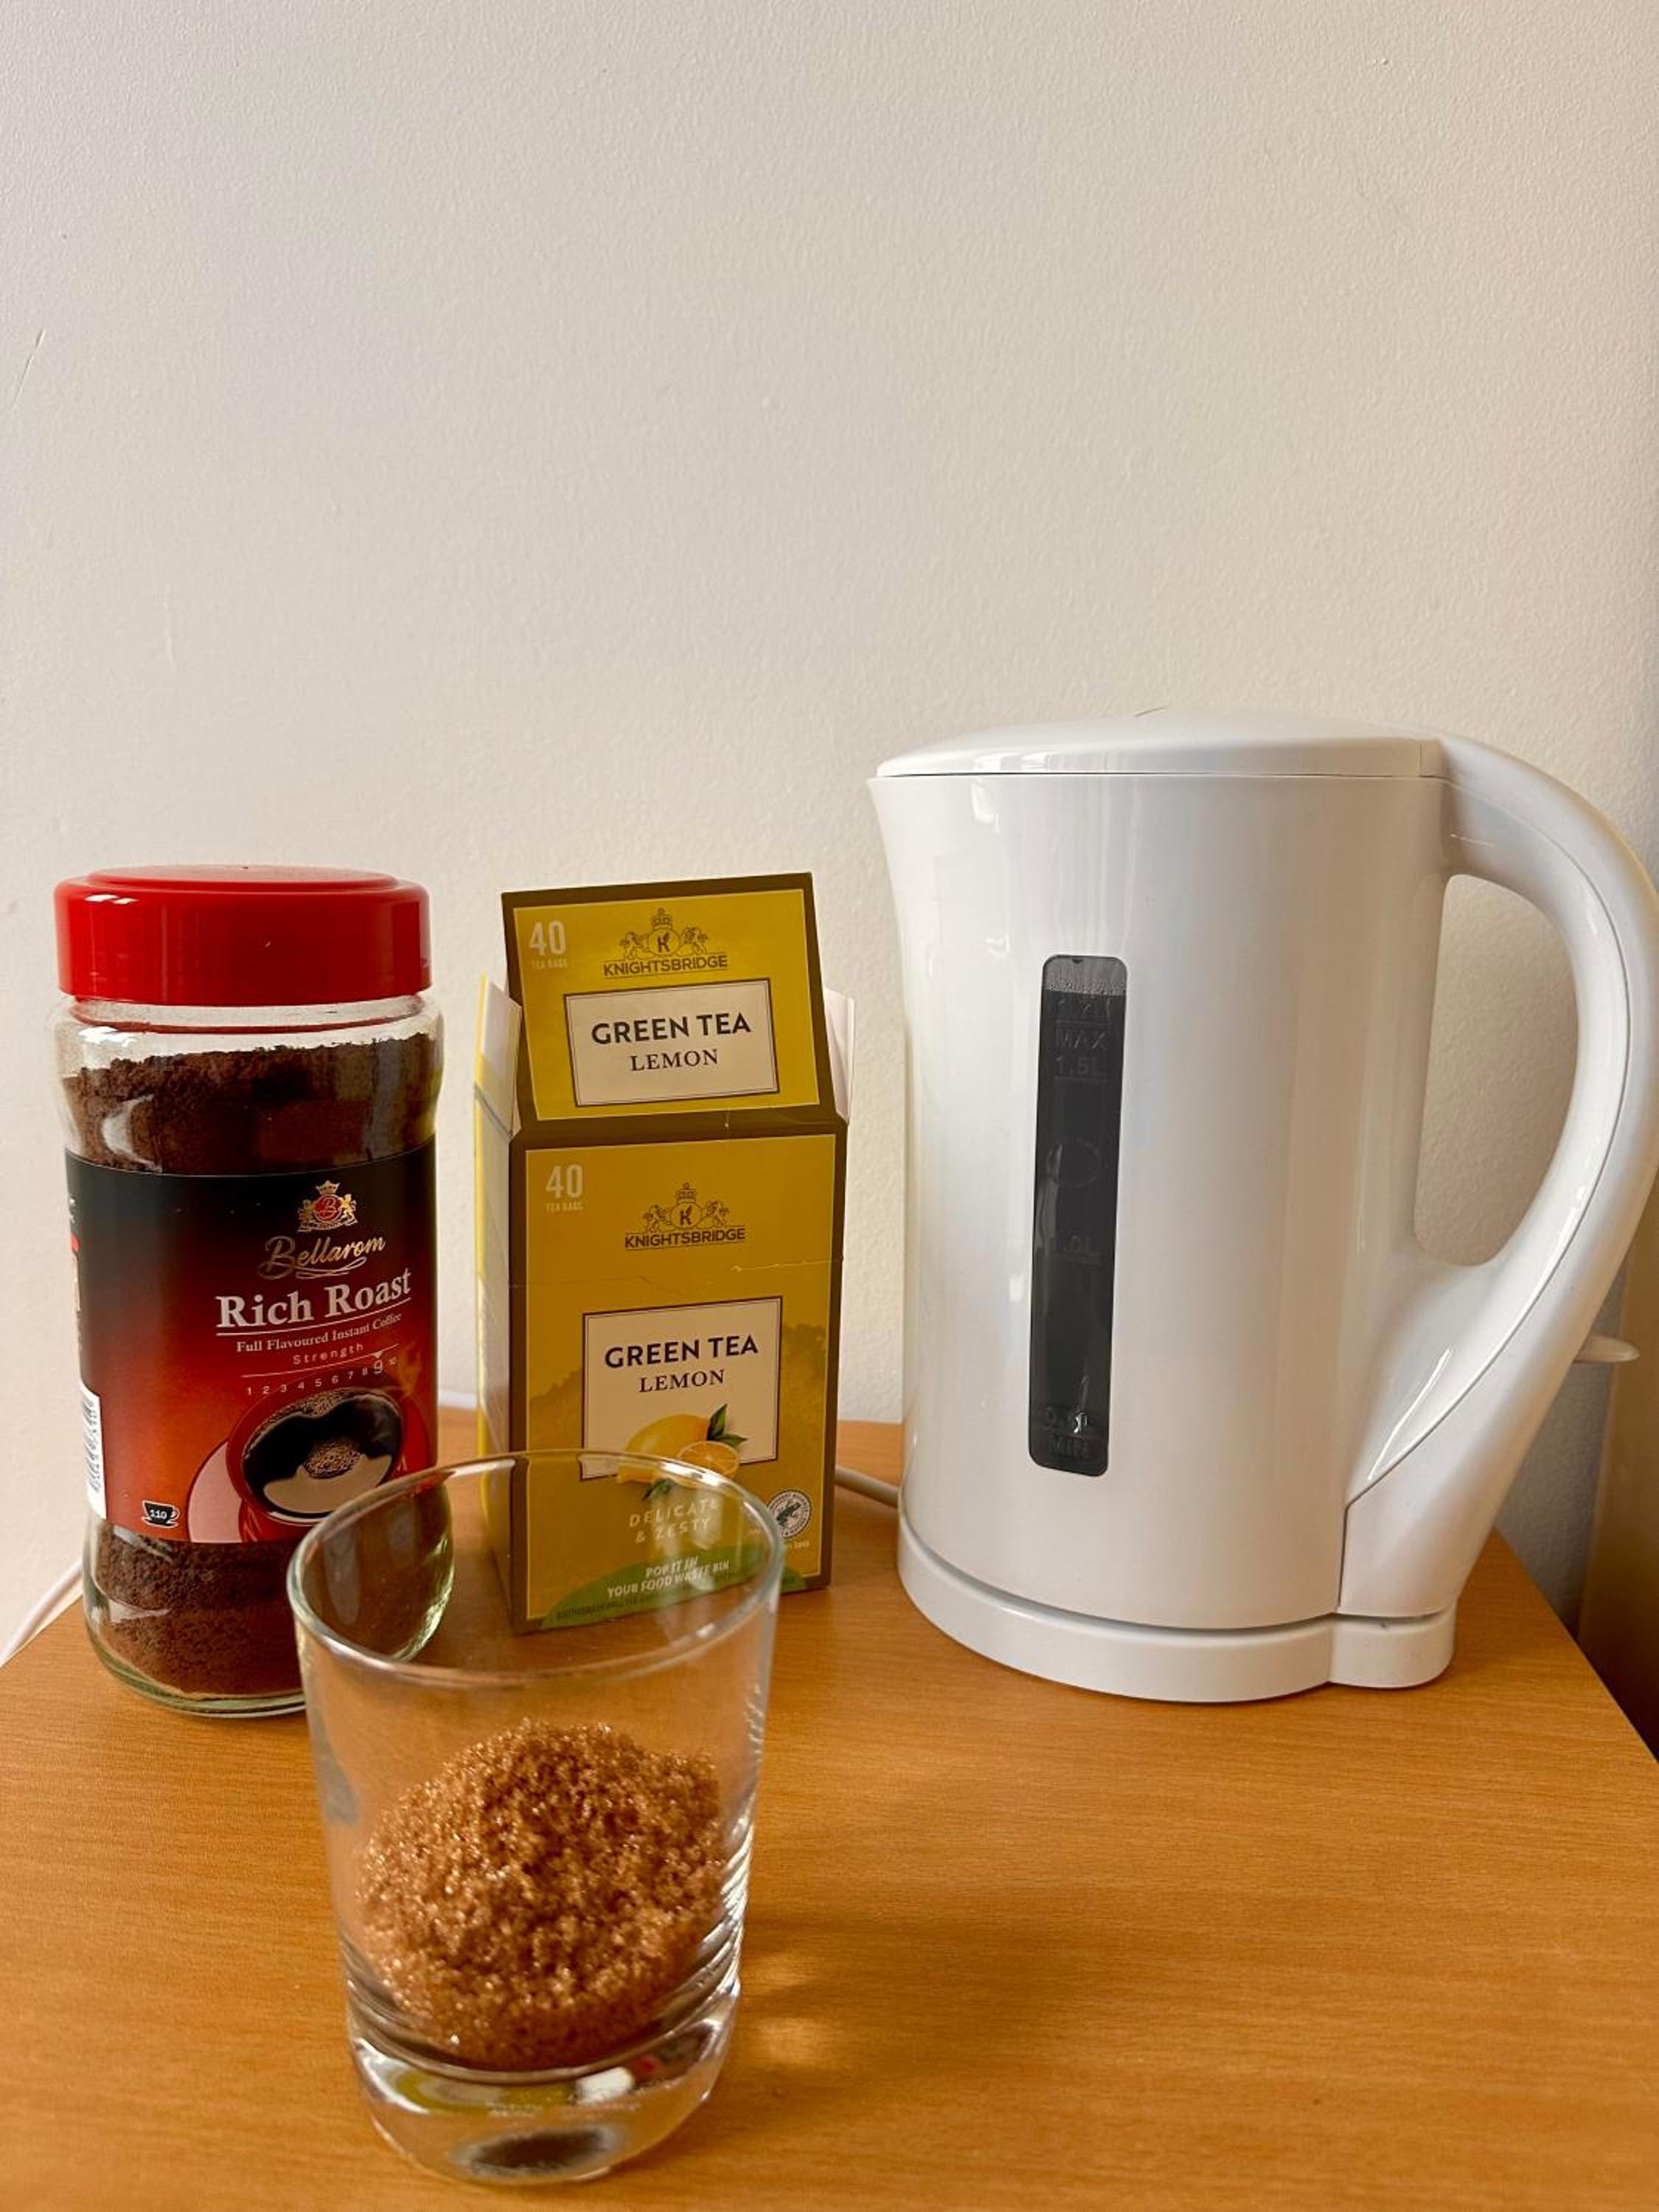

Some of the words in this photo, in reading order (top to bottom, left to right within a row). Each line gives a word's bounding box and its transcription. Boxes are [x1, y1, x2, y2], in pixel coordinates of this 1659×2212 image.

[529, 920, 567, 956] 40
[604, 955, 728, 976] KNIGHTSBRIDGE
[591, 1016, 689, 1044] GREEN
[696, 1012, 751, 1036] TEA
[1055, 1030, 1107, 1051] MAX
[630, 1048, 717, 1071] LEMON
[546, 1164, 583, 1198] 40
[625, 1228, 745, 1248] KNIGHTSBRIDGE
[258, 1235, 386, 1281] Bellarom
[215, 1291, 314, 1328] Rich
[324, 1267, 411, 1318] Roast
[236, 1340, 262, 1353] Full
[267, 1334, 329, 1351] Flavoured
[332, 1322, 370, 1341] Instant
[372, 1312, 403, 1330] Coffee
[293, 1343, 364, 1365] Strength
[605, 1340, 700, 1368] GREEN
[708, 1334, 758, 1358] TEA
[247, 1386, 252, 1396] 1
[262, 1385, 271, 1394] 2
[280, 1384, 288, 1393] 3
[298, 1381, 305, 1390] 4
[315, 1379, 323, 1388] 5
[332, 1375, 339, 1384] 6
[348, 1371, 354, 1380] 7
[373, 1359, 383, 1375] 9
[639, 1369, 725, 1393] LEMON
[629, 1498, 717, 1528] DELICATE
[636, 1531, 646, 1544] &
[655, 1517, 711, 1540] ZESTY
[607, 1584, 639, 1599] YOUR
[641, 1576, 673, 1593] FOOD
[674, 1563, 711, 1583] WASTE
[712, 1560, 730, 1573] BIN
[645, 1562, 668, 1579] POP
[672, 1559, 684, 1573] IT
[684, 1556, 699, 1570] IN
